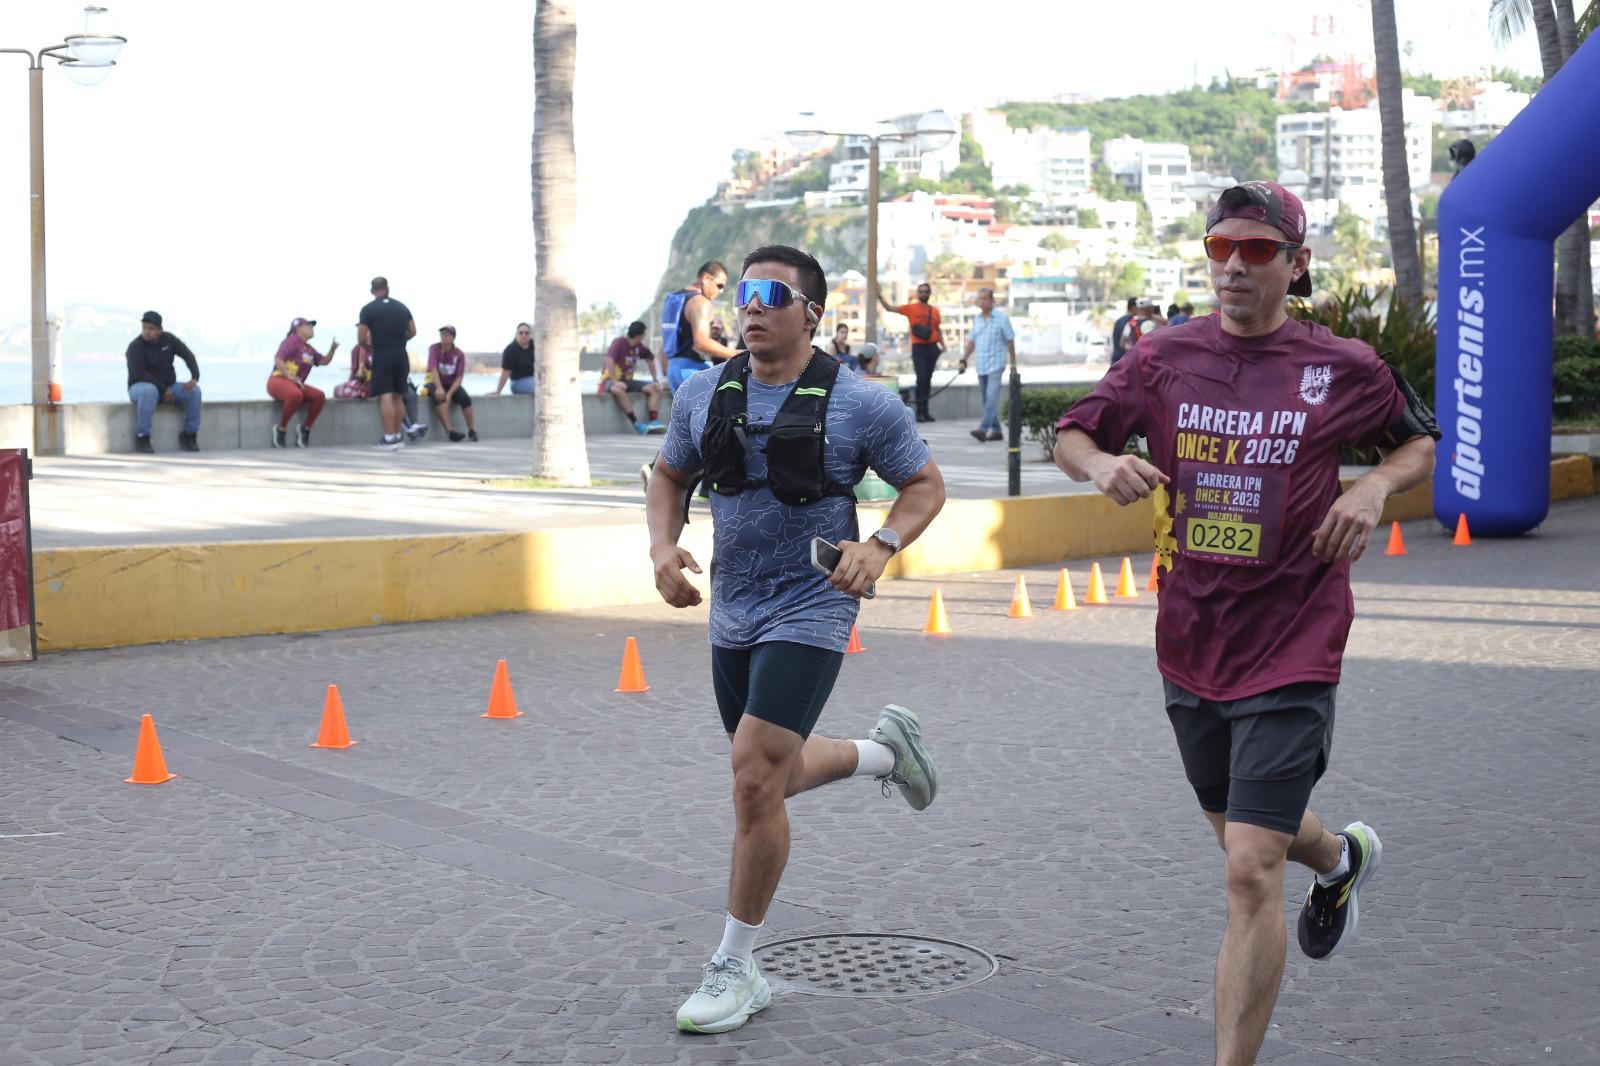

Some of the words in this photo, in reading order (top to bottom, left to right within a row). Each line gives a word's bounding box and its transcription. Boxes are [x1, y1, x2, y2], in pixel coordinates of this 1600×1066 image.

[1177, 402, 1263, 436] CARRERA
[1269, 410, 1307, 436] IPN
[1177, 432, 1221, 463] ONCE
[1225, 440, 1240, 464] K
[1243, 438, 1300, 465] 2026
[1197, 472, 1242, 489] CARRERA
[1244, 476, 1262, 491] IPN
[1195, 487, 1220, 504] ONCE
[1223, 490, 1231, 505] K
[1232, 491, 1260, 507] 2026
[1192, 523, 1253, 552] 0282
